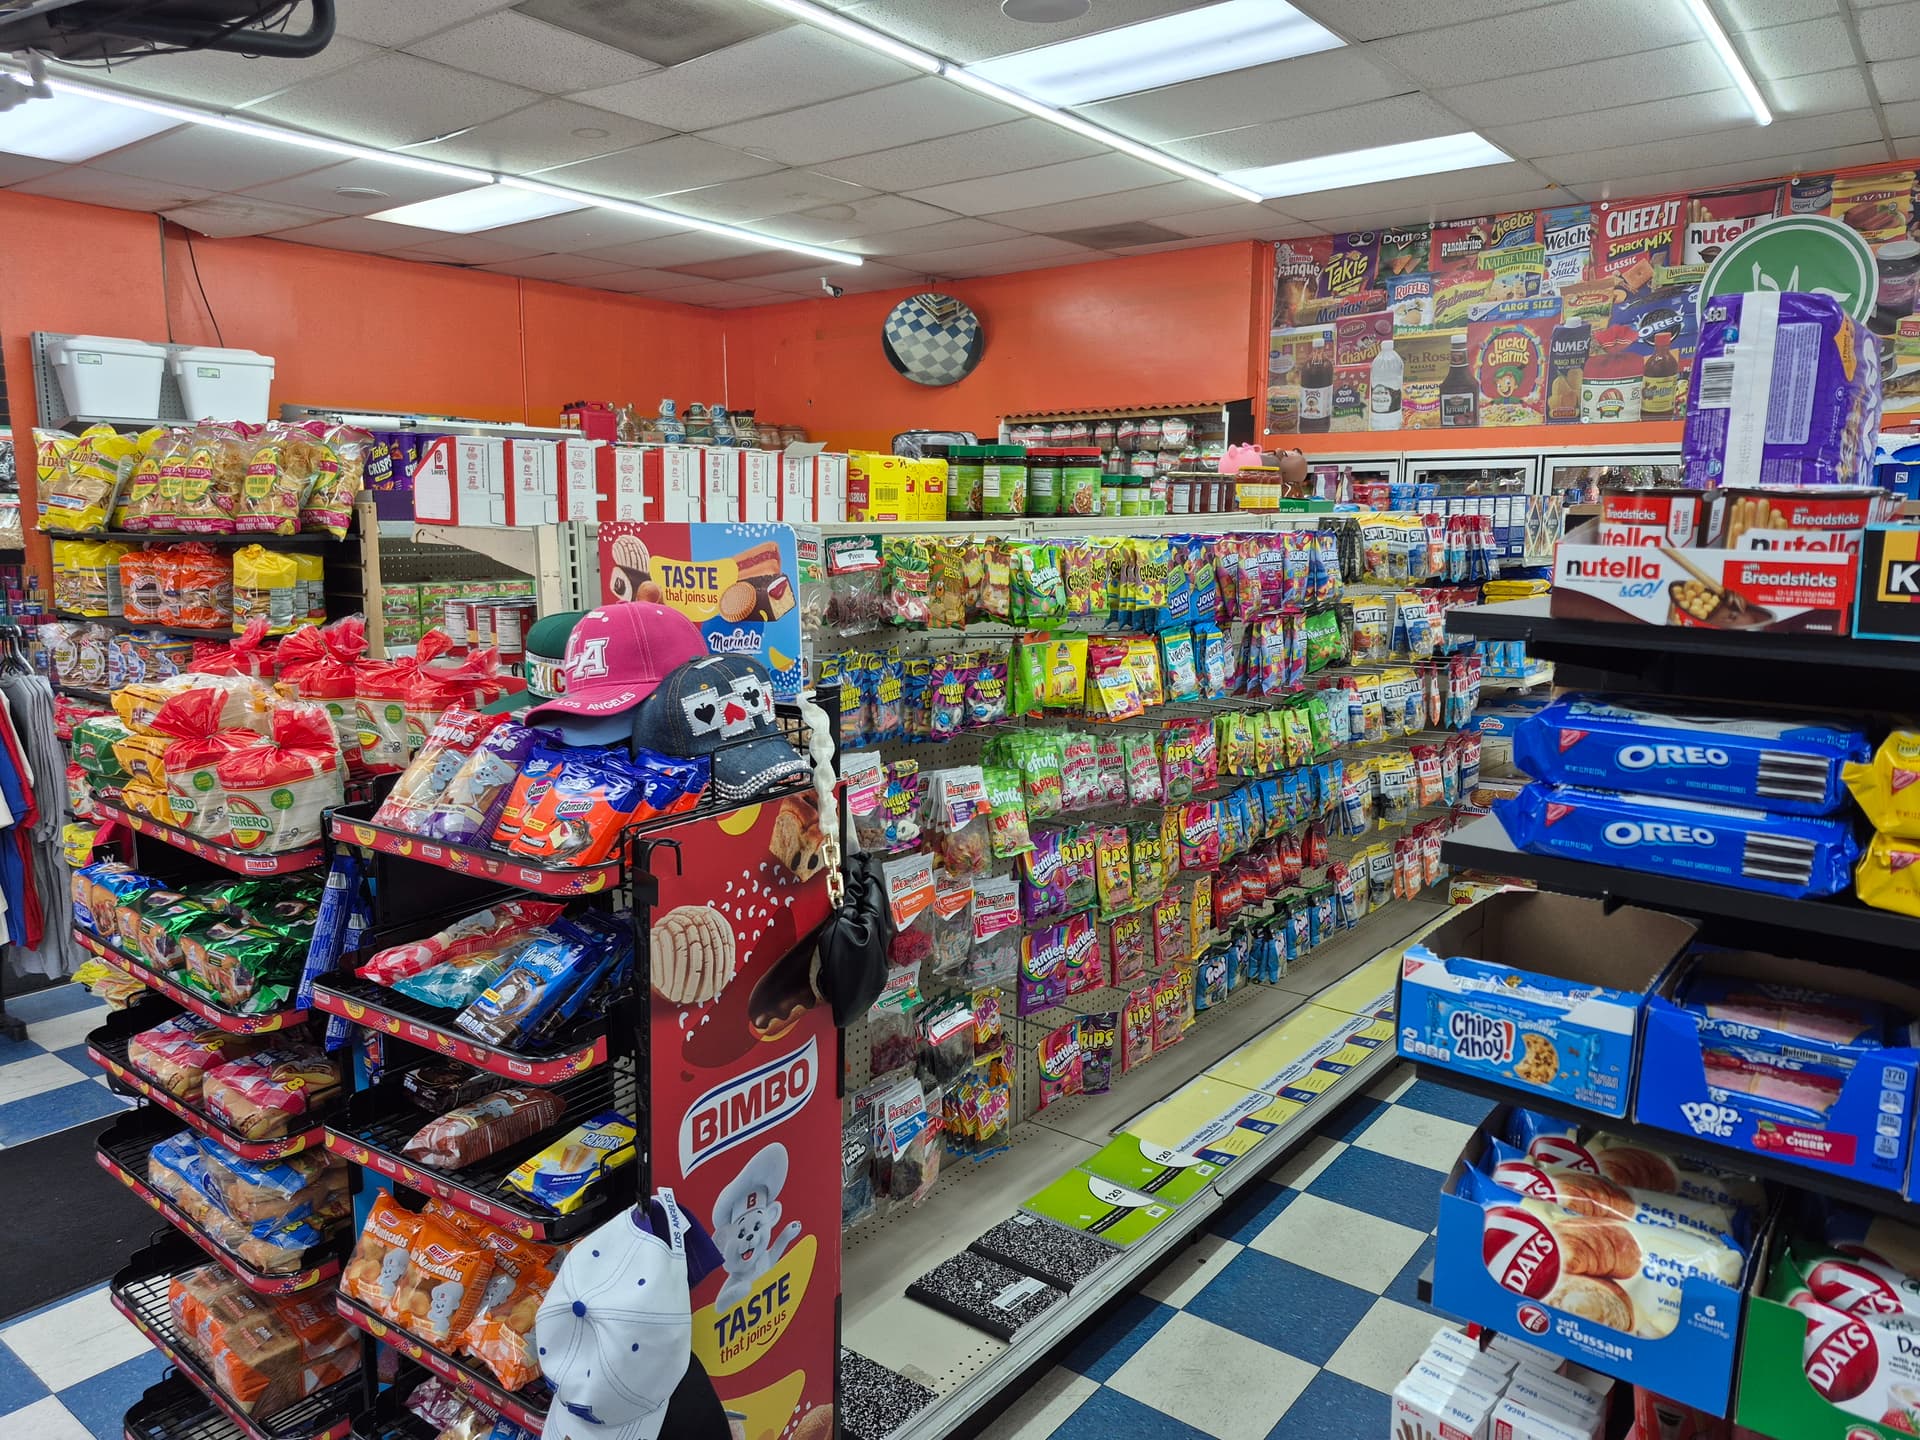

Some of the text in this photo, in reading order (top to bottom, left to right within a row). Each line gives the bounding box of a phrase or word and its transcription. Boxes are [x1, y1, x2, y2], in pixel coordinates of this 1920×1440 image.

[1383, 231, 1428, 245] Doritos
[1545, 226, 1591, 250] Welch's
[1691, 219, 1756, 245] nutell
[1609, 239, 1643, 257] Snack
[1486, 251, 1541, 269] NATURE VALLEY
[1557, 258, 1577, 269] Fruit
[1604, 256, 1637, 272] CLASSIC
[1325, 255, 1368, 290] Takis
[1551, 266, 1580, 277] Snacks
[1395, 282, 1429, 299] RUFFLES
[1500, 300, 1554, 312] LARGE SIZE
[1639, 315, 1684, 338] OREO
[1494, 337, 1528, 352] Lucky
[1553, 338, 1590, 353] JUMEX
[1488, 352, 1530, 367] Charms
[1792, 512, 1860, 526] Breadsticks
[1139, 564, 1168, 581] Gushers
[1566, 556, 1662, 579] nutella
[1743, 563, 1760, 571] with
[662, 565, 719, 590] TASTE
[1742, 571, 1837, 588] Breadsticks
[665, 589, 719, 605] that joins us
[1170, 591, 1189, 609] JOLLY
[1197, 589, 1216, 607] JOLLY
[709, 631, 761, 650] Marinela
[566, 631, 610, 682] LA
[526, 661, 566, 693] EXIC
[558, 691, 635, 710] LOS ANGELES
[1618, 745, 1729, 768] OREO
[528, 783, 550, 798] Gansit
[557, 800, 593, 813] Gansito
[1185, 817, 1217, 838] Skittles
[1604, 822, 1715, 845] OREO
[247, 860, 275, 869] BIMBO
[1032, 851, 1062, 877] Skittles
[1066, 927, 1096, 957] Skittles
[1028, 944, 1065, 973] Skittles
[1452, 1012, 1503, 1038] Chips
[1458, 1027, 1515, 1060] Ahoy!
[1045, 1041, 1079, 1073] Skittles
[1885, 1069, 1906, 1080] 370
[691, 1057, 810, 1155] BIMBO
[1692, 1121, 1733, 1137] tarts
[1786, 1137, 1832, 1152] CHERRY
[1156, 1150, 1172, 1162] 120
[1105, 1188, 1123, 1201] 120
[1682, 1180, 1714, 1202] Soft
[664, 1192, 683, 1248] LOS ANGELES
[1641, 1203, 1675, 1221] Soft
[1485, 1215, 1538, 1283] 7
[1506, 1232, 1553, 1294] DAYS
[1648, 1252, 1686, 1273] Soft
[1642, 1266, 1684, 1288] Croi
[714, 1272, 791, 1349] TASTE
[1658, 1297, 1680, 1308] vani
[1704, 1304, 1716, 1317] 6
[1556, 1317, 1578, 1330] soft
[1694, 1312, 1725, 1330] Count
[720, 1309, 787, 1364] that joins us
[1556, 1325, 1633, 1361] croissant
[1807, 1324, 1869, 1391] DAYS
